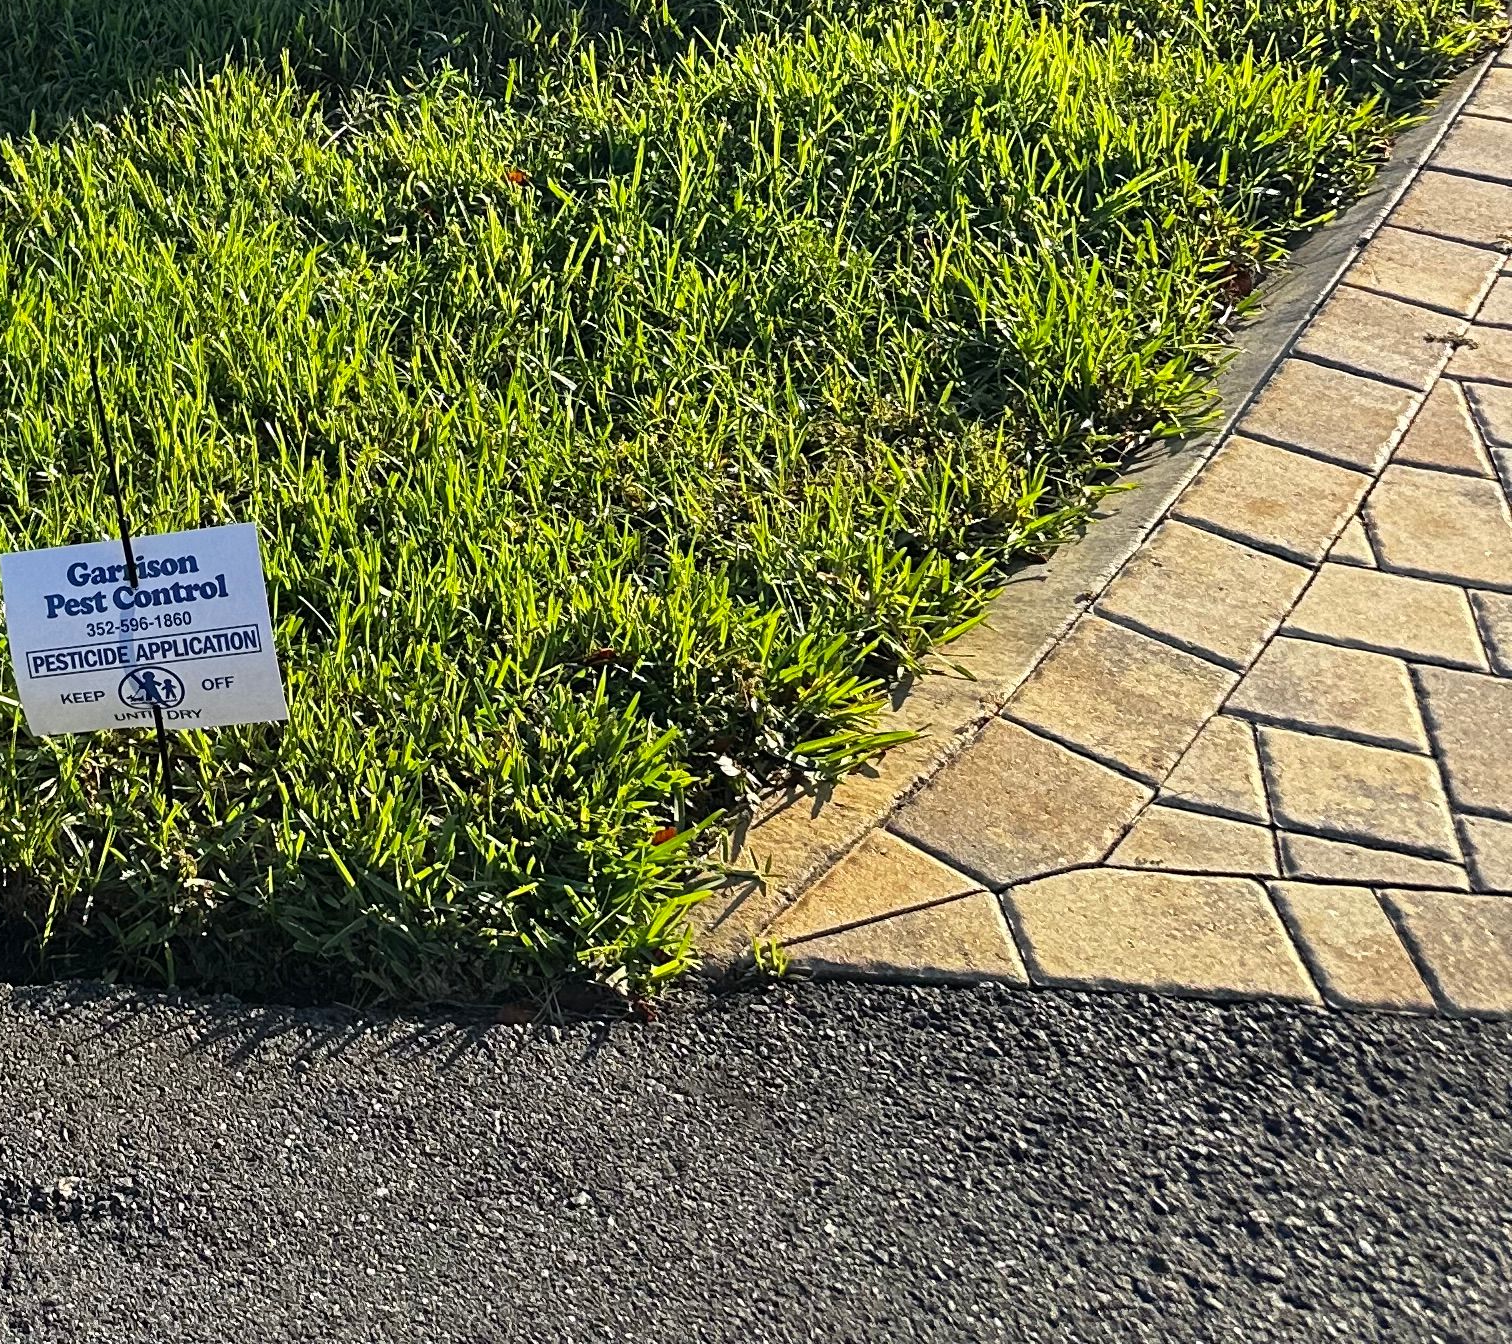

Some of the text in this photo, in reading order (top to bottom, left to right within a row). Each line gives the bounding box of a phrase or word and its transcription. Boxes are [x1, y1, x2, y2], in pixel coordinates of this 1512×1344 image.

[44, 575, 229, 618] Pest Control
[86, 611, 192, 637] 352-596-1860
[33, 630, 258, 673] PESTICIDE APPLICATION
[60, 676, 235, 705] KEEP OFF
[113, 708, 203, 722] UNTI DRY
